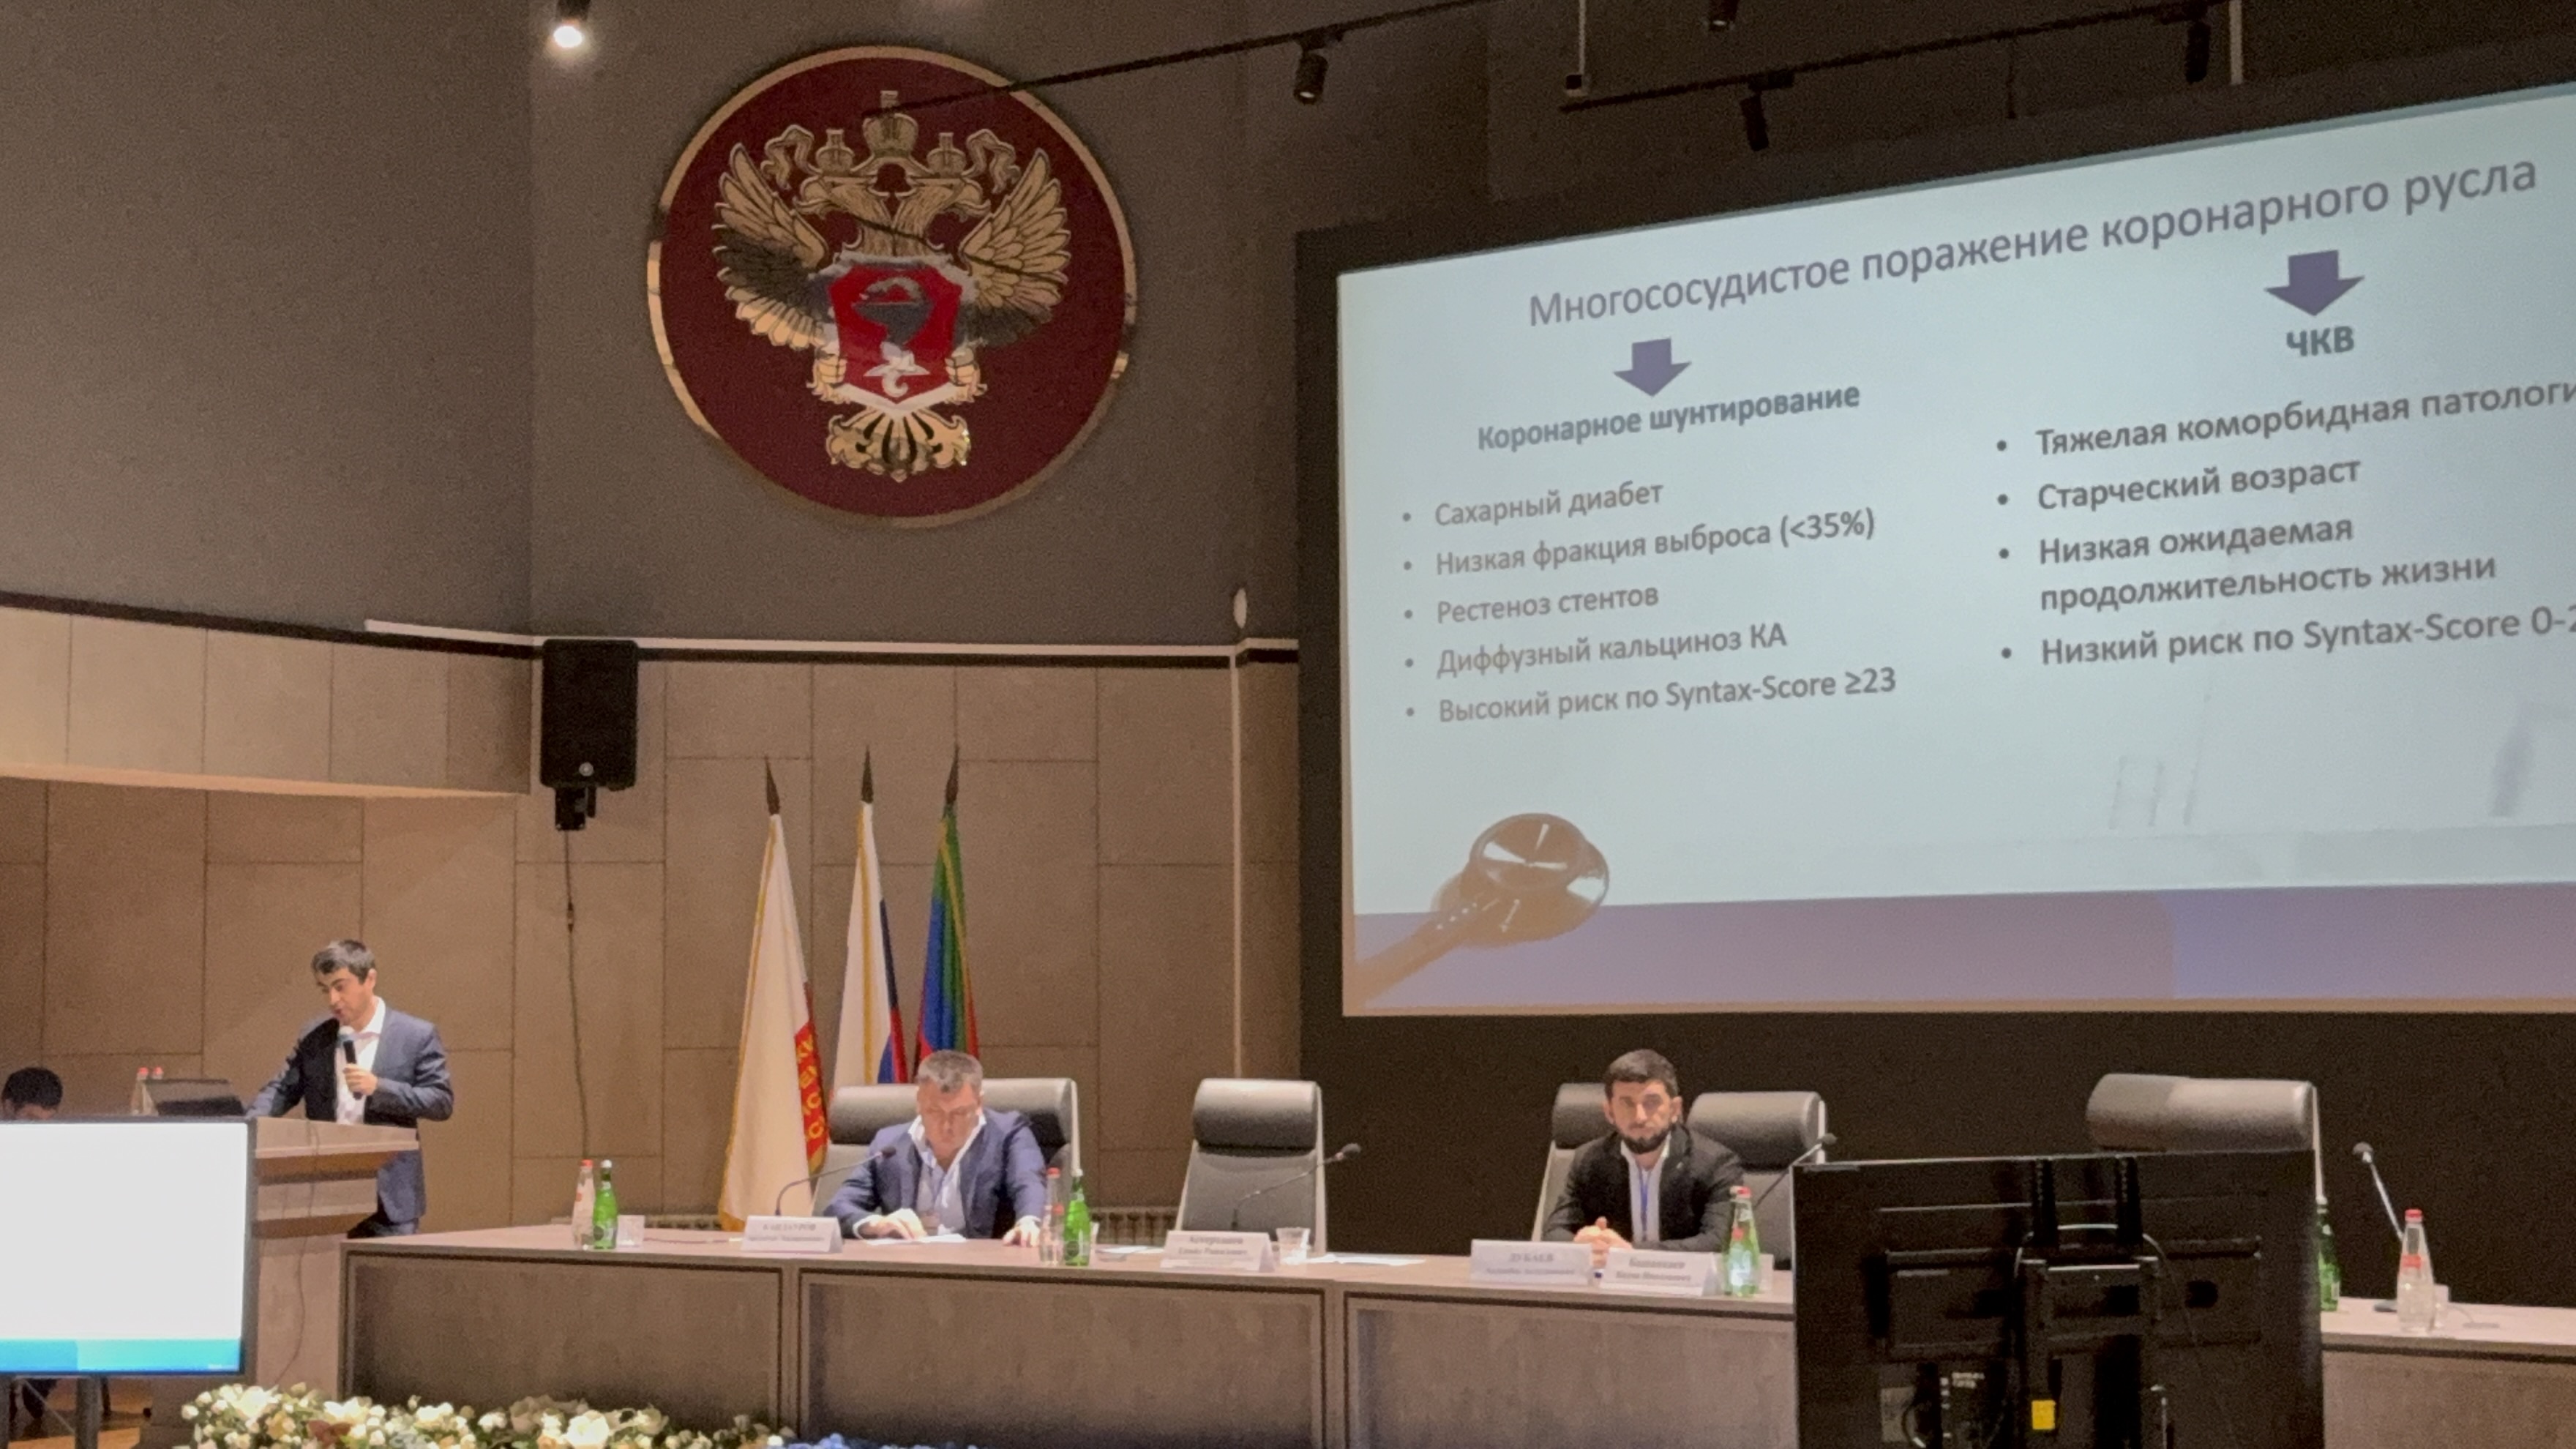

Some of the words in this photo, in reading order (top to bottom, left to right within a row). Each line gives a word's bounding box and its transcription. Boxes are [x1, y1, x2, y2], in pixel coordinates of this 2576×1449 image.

[1530, 258, 1849, 326] Многососудистое
[1863, 225, 2088, 283] поражение
[2103, 182, 2389, 250] коронарного
[2405, 162, 2536, 215] русла
[2286, 326, 2354, 356] ЧКВ
[1478, 413, 1641, 452] Коронарное
[1650, 386, 1860, 433] шунтирование
[2035, 424, 2167, 455] Тяжелая
[2178, 398, 2410, 441] коморбидная
[1435, 490, 1561, 526] Сахарный
[1568, 480, 1663, 517] диабет
[2038, 466, 2220, 512] Старческий
[2231, 460, 2361, 493] возраст
[1437, 550, 1524, 574] Низкая
[1533, 538, 1646, 570] фракция
[1655, 523, 1771, 555] выброса
[1780, 507, 1875, 547] (<35%)
[2040, 536, 2149, 564] Низкая
[2160, 520, 2353, 555] ожидаемая
[1438, 597, 1551, 623] Рестеноз
[1558, 588, 1659, 613] стентов
[2041, 568, 2372, 615] продолжительность
[2382, 558, 2496, 585] жизни
[1437, 637, 1590, 678] Диффузный
[1600, 632, 1742, 659] кальциноз
[1750, 622, 1787, 648] КА
[2043, 631, 2157, 665] Низкий
[2169, 632, 2243, 663] риск
[2254, 629, 2294, 652] по
[2304, 613, 2520, 654] Syntax-Score
[1440, 692, 1549, 722] Высокий
[1559, 693, 1618, 719] риск
[1626, 689, 1658, 708] по
[1666, 675, 1836, 711] Syntax-Score
[1845, 667, 1896, 694] ≥23
